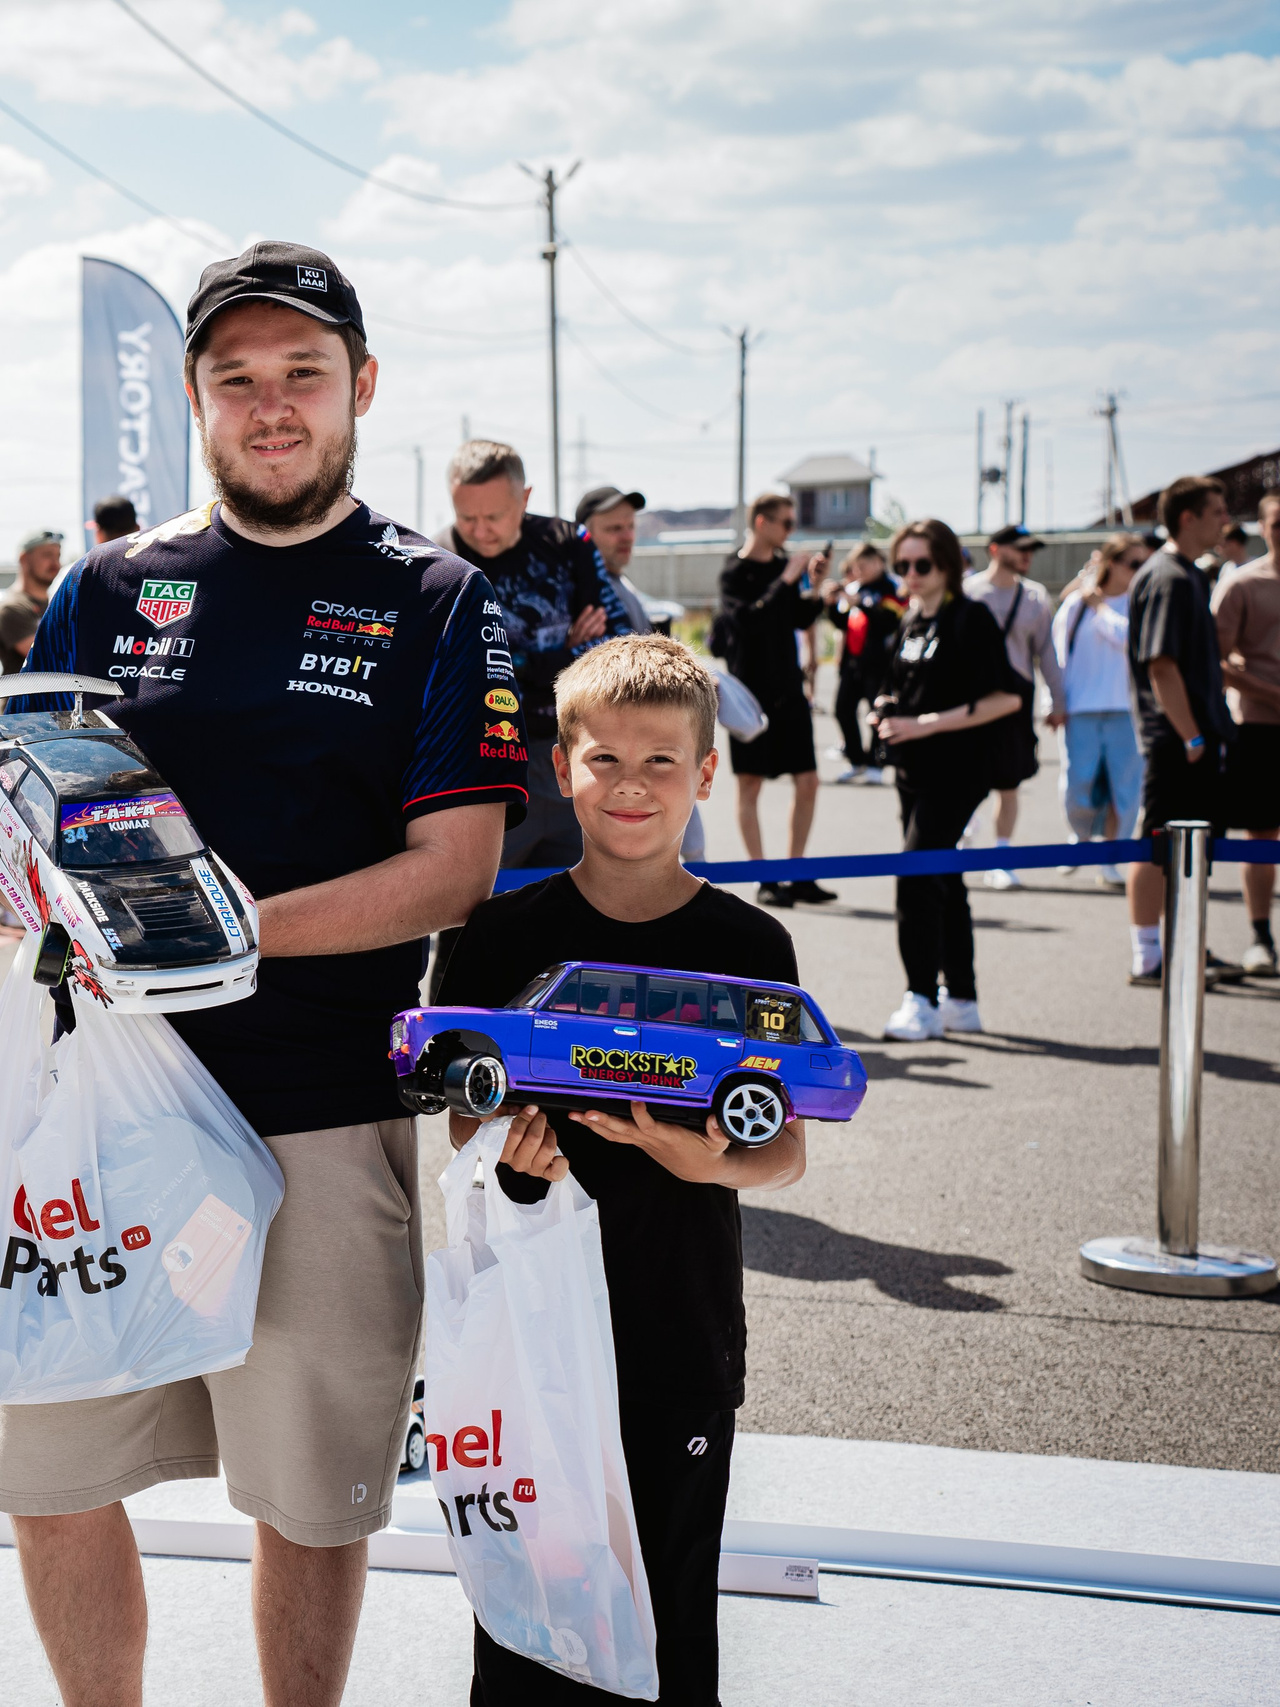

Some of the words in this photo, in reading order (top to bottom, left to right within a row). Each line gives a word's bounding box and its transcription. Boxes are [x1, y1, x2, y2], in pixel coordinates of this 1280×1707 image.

[300, 277, 325, 289] MAR
[304, 269, 320, 279] KU
[147, 582, 191, 599] TAG
[140, 600, 189, 624] HEUER
[311, 599, 399, 623] ORACLE
[306, 615, 332, 629] Red
[330, 620, 356, 632] Bull
[112, 635, 172, 656] Mobil
[179, 639, 187, 655] 1
[303, 631, 392, 649] RACING
[108, 665, 187, 681] ORACLE
[299, 652, 378, 681] BYBIT
[286, 679, 374, 707] HONDA
[480, 742, 508, 759] Red
[508, 744, 529, 762] Bull
[63, 826, 89, 845] 34
[108, 820, 151, 832] KUMAR
[76, 880, 110, 923] DARKSIDE
[534, 1018, 558, 1027] ENEOS
[760, 1011, 785, 1031] 10
[740, 1055, 782, 1071] AEM
[580, 1067, 635, 1083] ENERGY
[640, 1073, 682, 1088] DRINK
[0, 1235, 127, 1298] Parts
[127, 1230, 145, 1245] ru
[517, 1483, 534, 1496] ru
